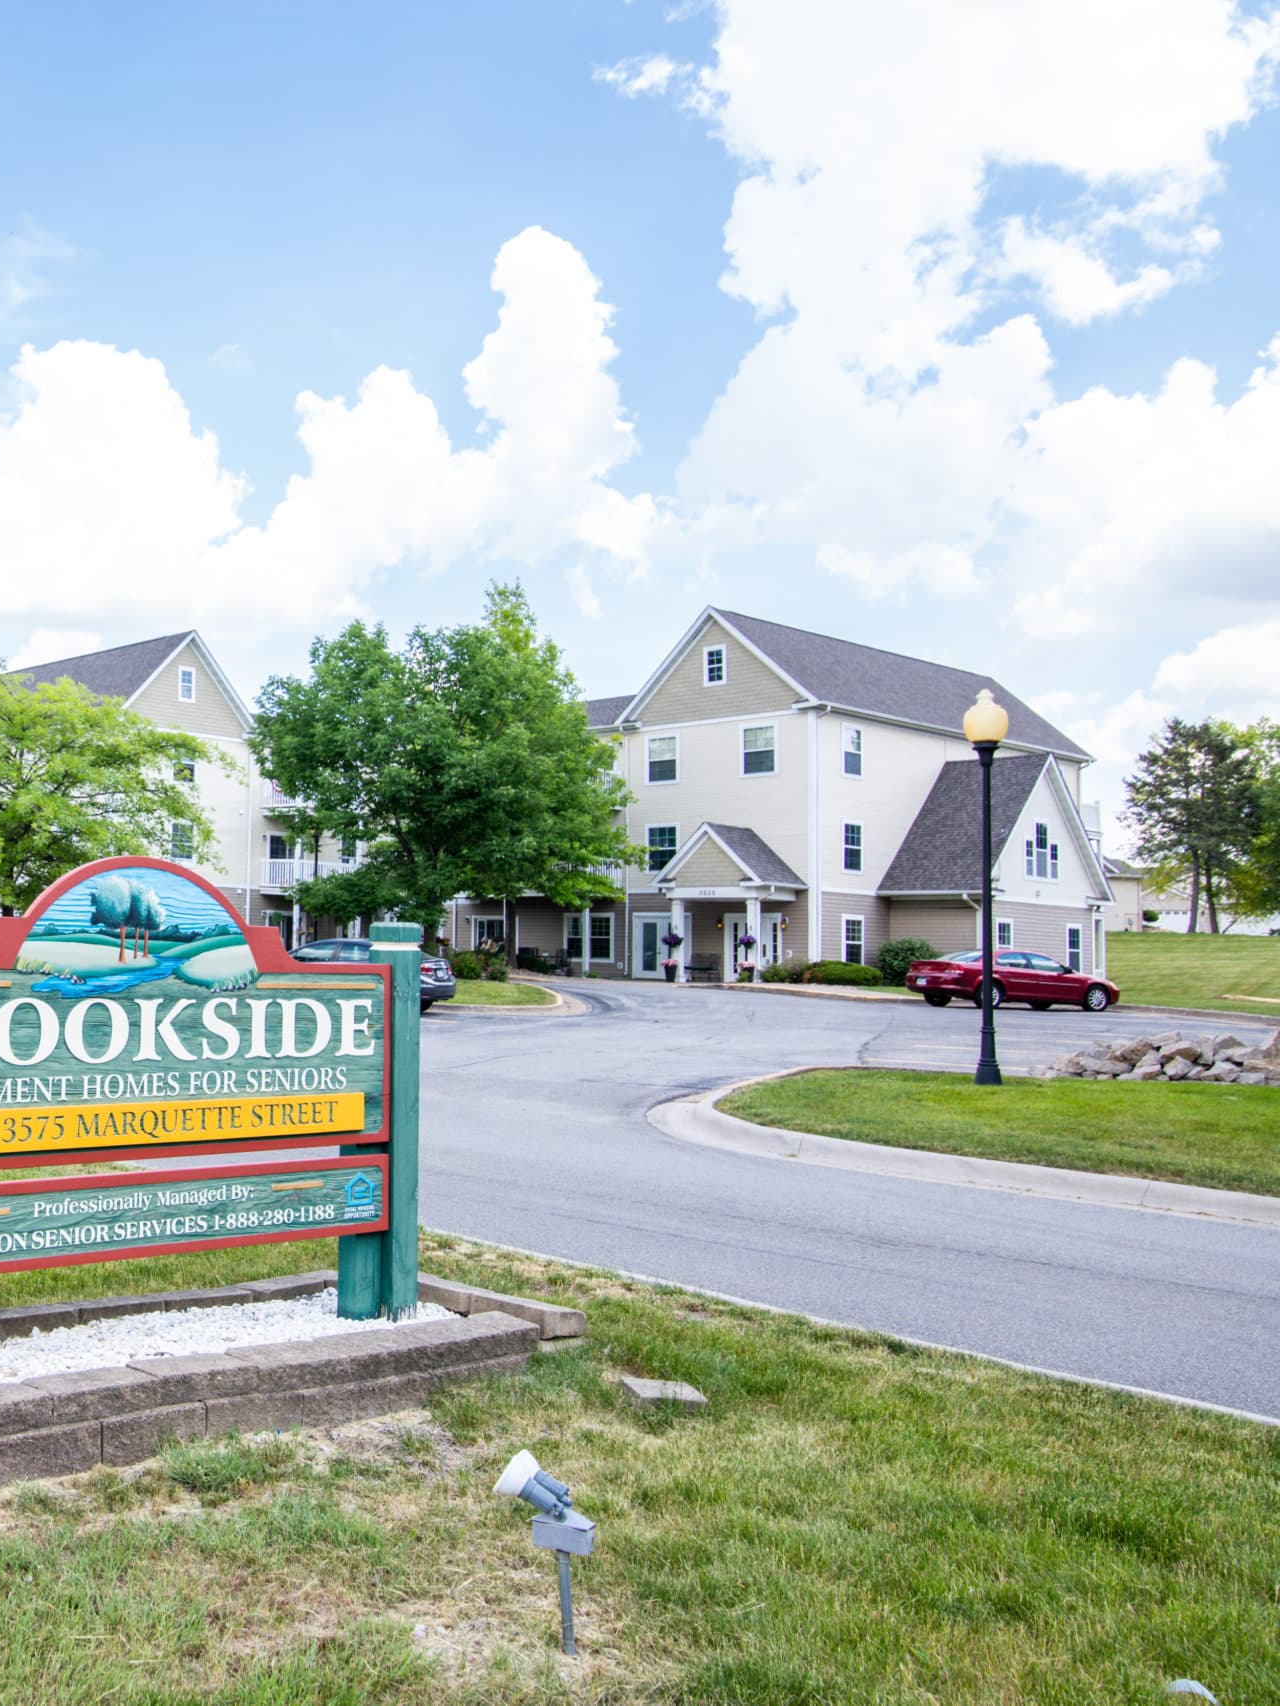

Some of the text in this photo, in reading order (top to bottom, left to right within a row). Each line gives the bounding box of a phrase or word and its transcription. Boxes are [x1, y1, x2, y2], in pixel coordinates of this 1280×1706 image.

[82, 1071, 180, 1100] HOMES
[188, 1070, 239, 1095] FOR
[246, 1066, 347, 1093] SENIORS
[1, 1114, 65, 1143] 3575
[76, 1105, 242, 1138] MARQUETTE
[251, 1101, 338, 1127] STREET
[33, 1184, 254, 1218] Professionally Managed By:
[31, 1225, 110, 1250] SENIOR
[113, 1215, 208, 1241] SERVICES
[214, 1204, 335, 1231] 1-888-280-1188
